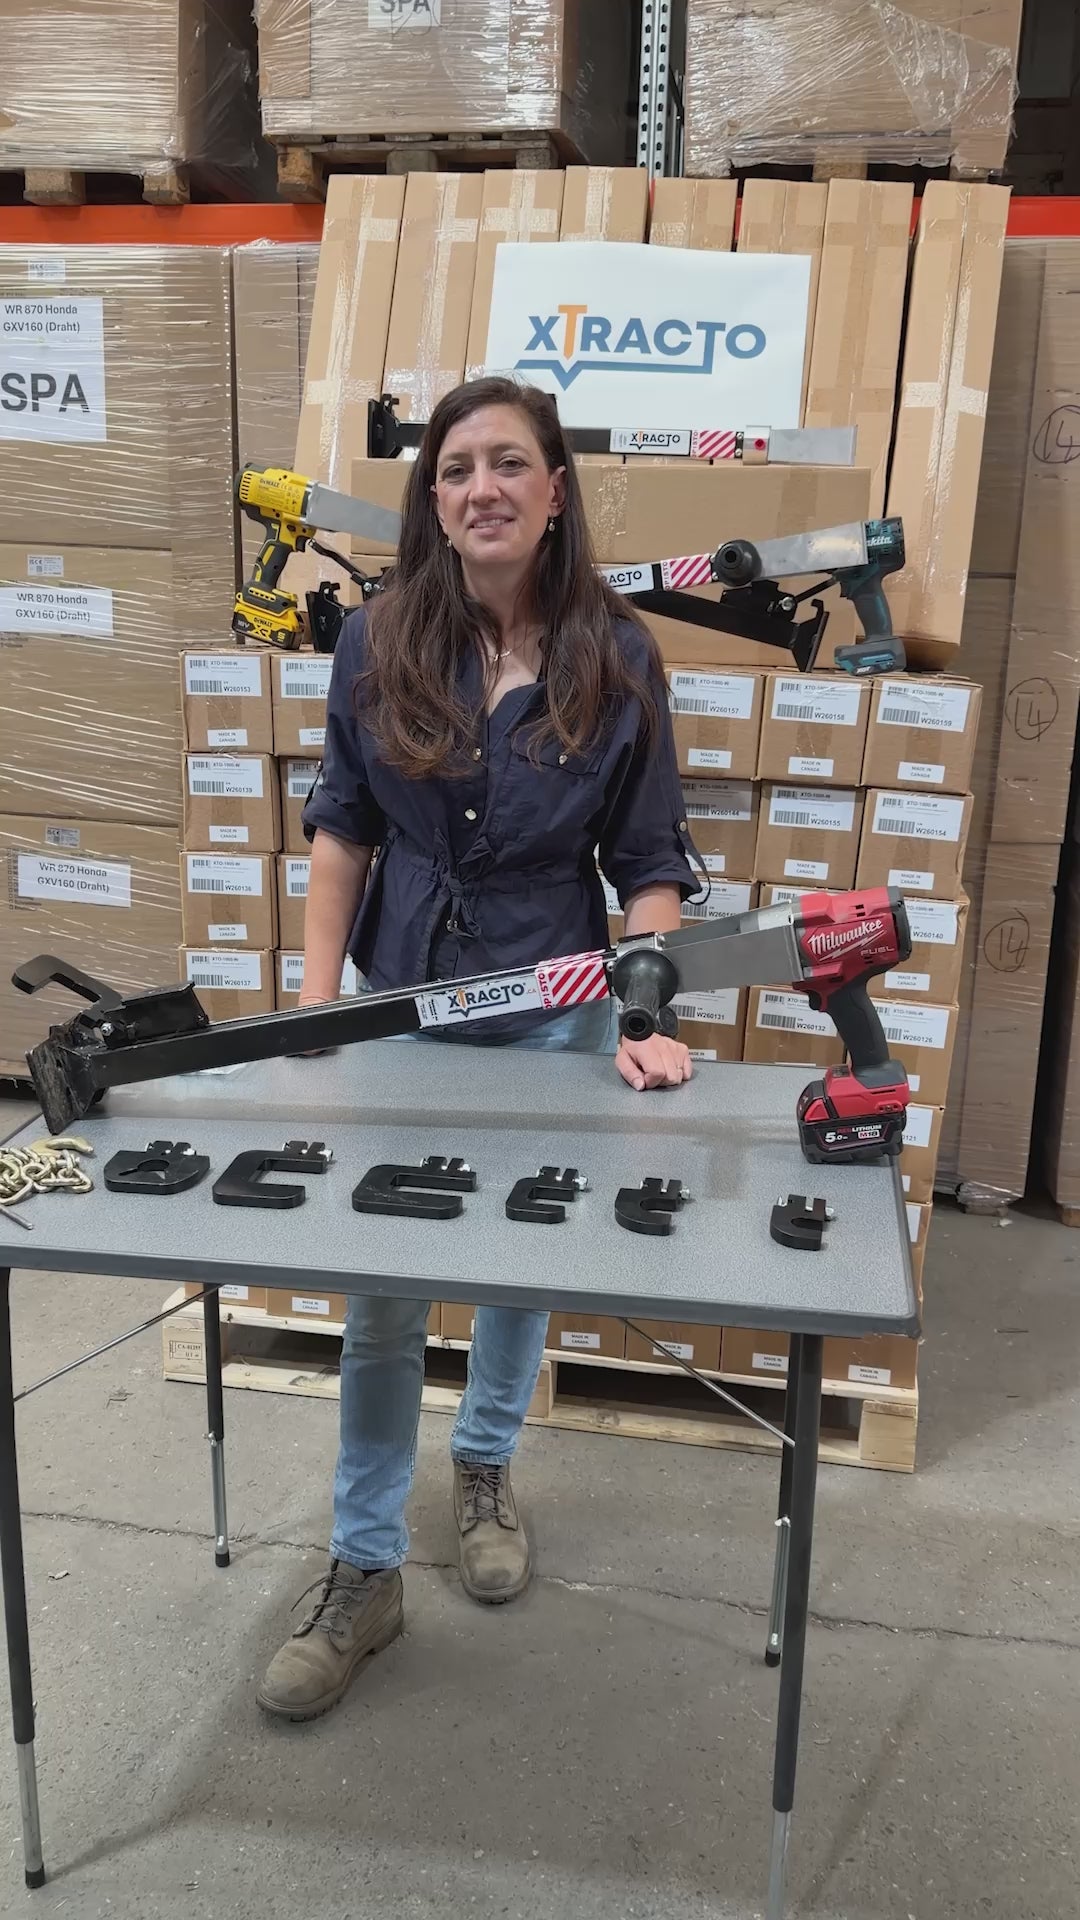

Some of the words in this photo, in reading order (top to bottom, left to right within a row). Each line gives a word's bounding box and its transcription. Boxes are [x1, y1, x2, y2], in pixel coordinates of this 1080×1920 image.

[5, 304, 23, 315] WR
[24, 304, 43, 315] 870
[45, 304, 78, 315] Honda
[3, 322, 43, 332] GXV160
[45, 322, 81, 334] (Draht)
[524, 304, 766, 361] XTRACTO
[0, 372, 90, 413] SPA
[867, 536, 892, 546] akita
[16, 593, 34, 602] WR
[36, 594, 54, 603] 870
[56, 594, 88, 604] Honda
[16, 609, 54, 619] GXV160
[56, 610, 91, 622] (Draht)
[709, 706, 740, 714] W260157
[921, 717, 952, 727] W260159
[915, 827, 947, 836] W260154
[39, 862, 56, 872] WR
[77, 866, 107, 877] Honda
[37, 876, 74, 888] GXV160
[76, 880, 110, 893] (Draht)
[808, 919, 883, 954] Milwaukee
[448, 983, 525, 1009] XTRACTO
